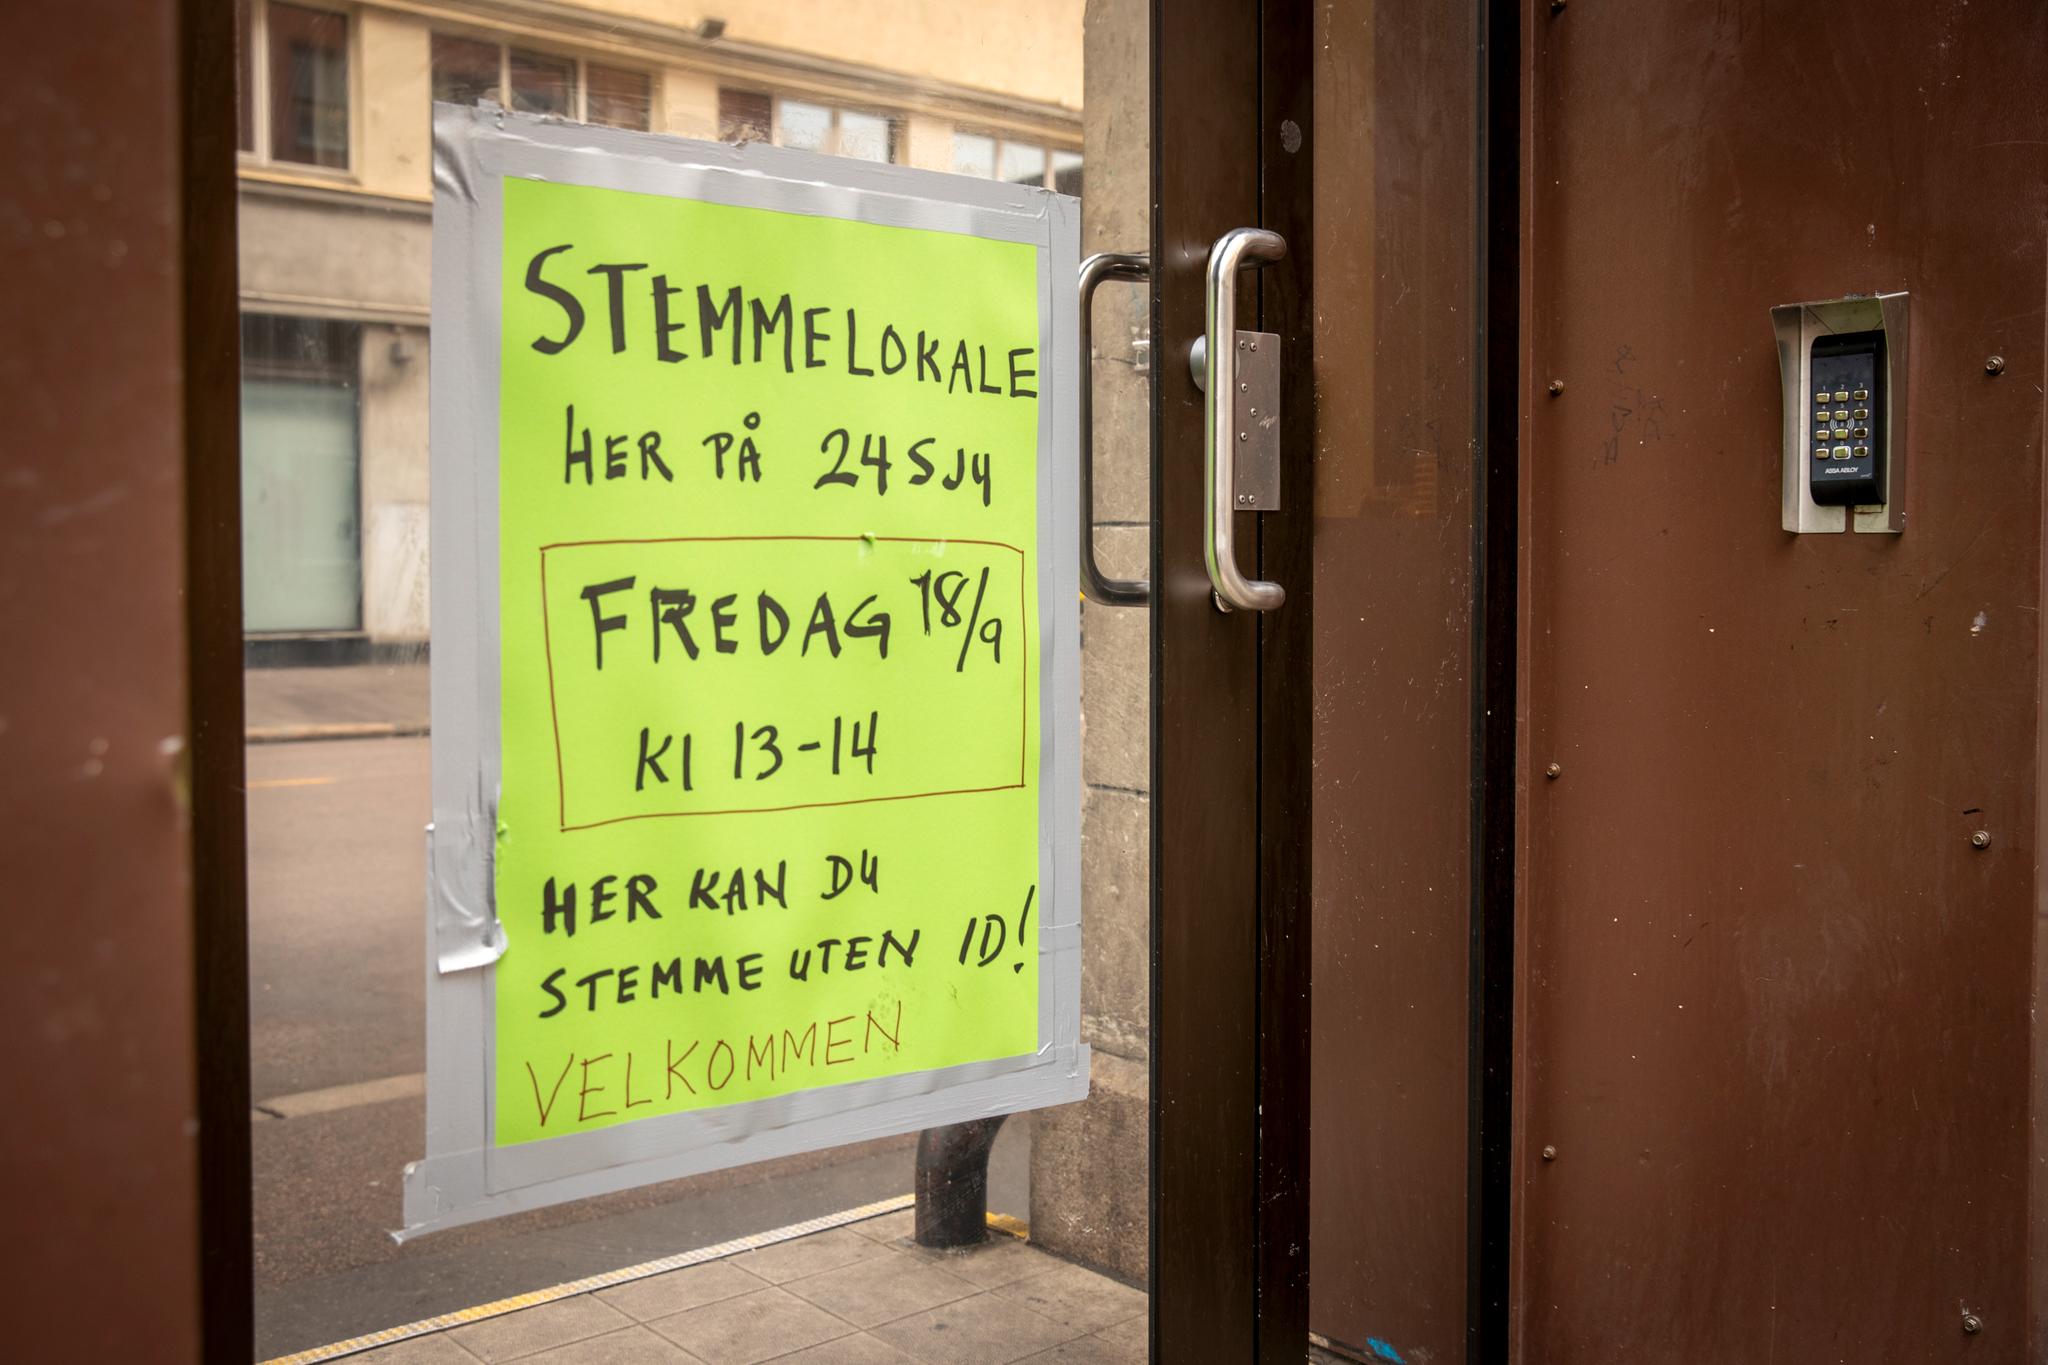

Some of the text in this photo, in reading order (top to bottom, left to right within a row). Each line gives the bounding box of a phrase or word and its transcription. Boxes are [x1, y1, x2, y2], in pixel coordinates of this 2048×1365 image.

[525, 245, 1037, 398] STEMMELOKALE
[565, 405, 673, 484] HER
[703, 412, 761, 482] PÅ
[581, 567, 1001, 672] FREDAG 18/9
[735, 712, 877, 780] 13-14
[542, 850, 877, 937] HER KAN DU
[540, 954, 762, 1018] STEMME
[959, 885, 1036, 973] ID!
[527, 1001, 900, 1126] VELKOMMEN
